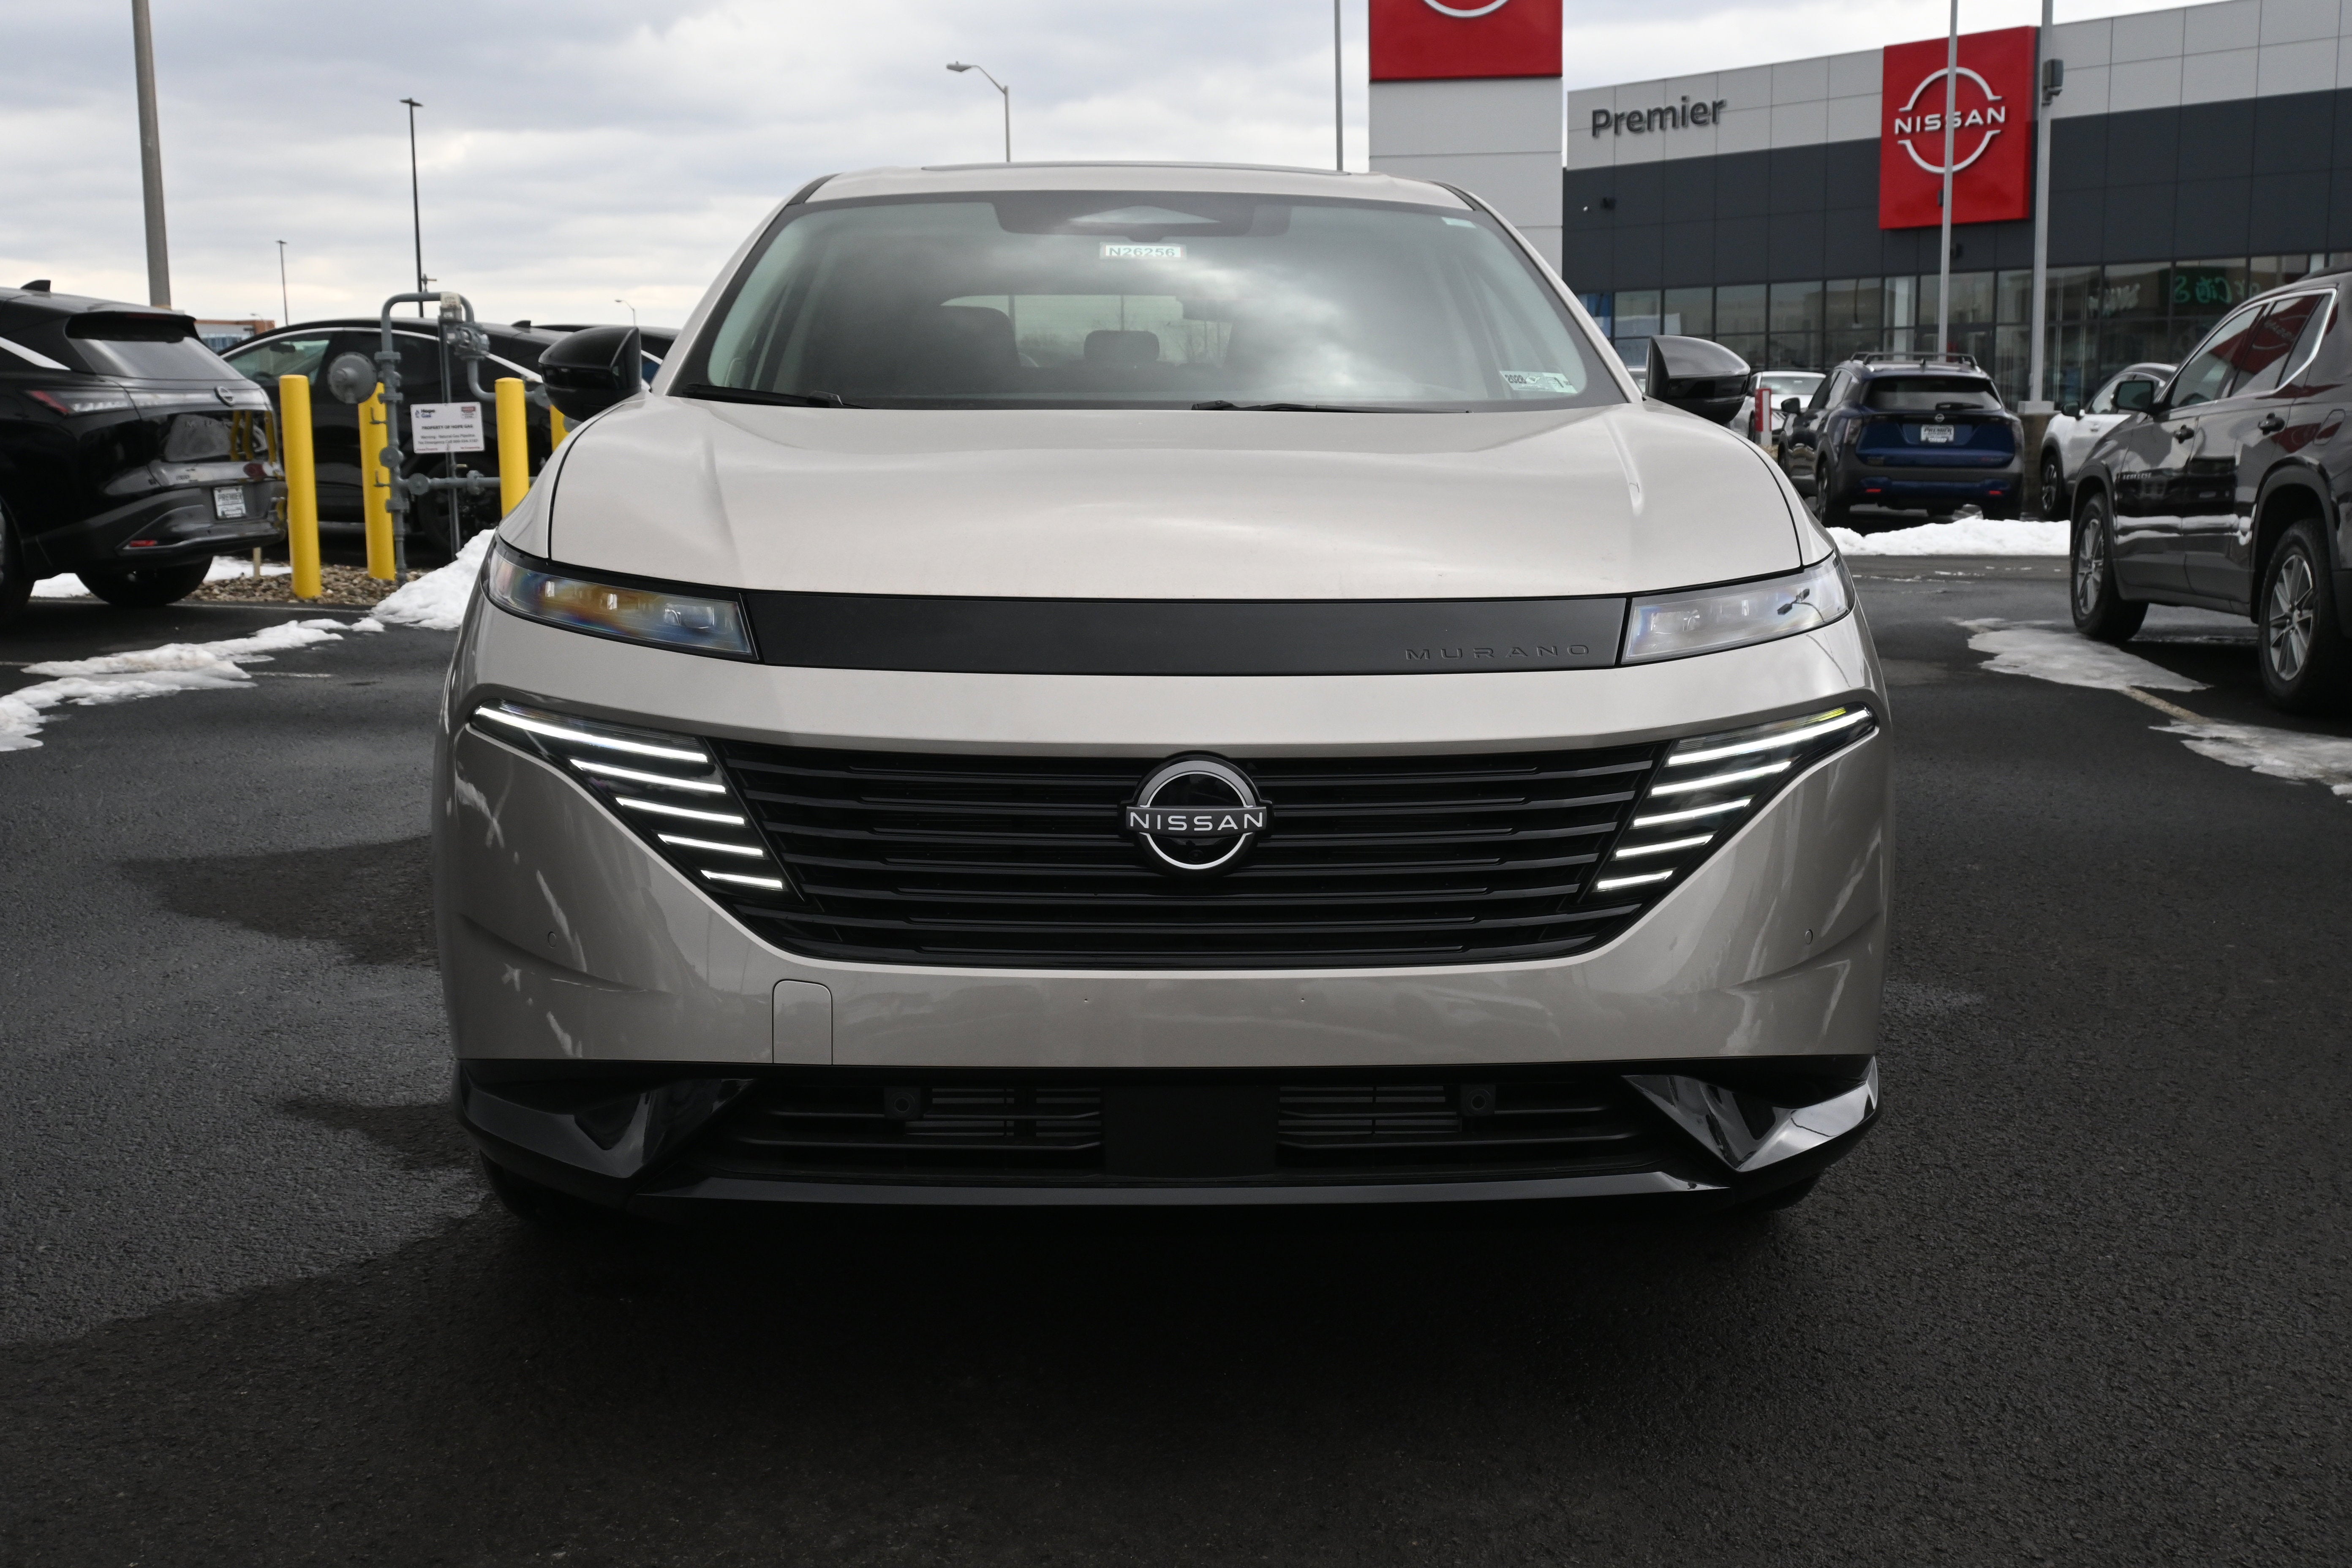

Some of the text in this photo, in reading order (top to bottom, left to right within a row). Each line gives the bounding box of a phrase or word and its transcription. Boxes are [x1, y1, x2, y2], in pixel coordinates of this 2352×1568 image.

[1592, 95, 1727, 138] Premier
[1109, 248, 1175, 257] N26256
[1405, 645, 1589, 660] MURANO
[1130, 812, 1263, 831] NISSAN
